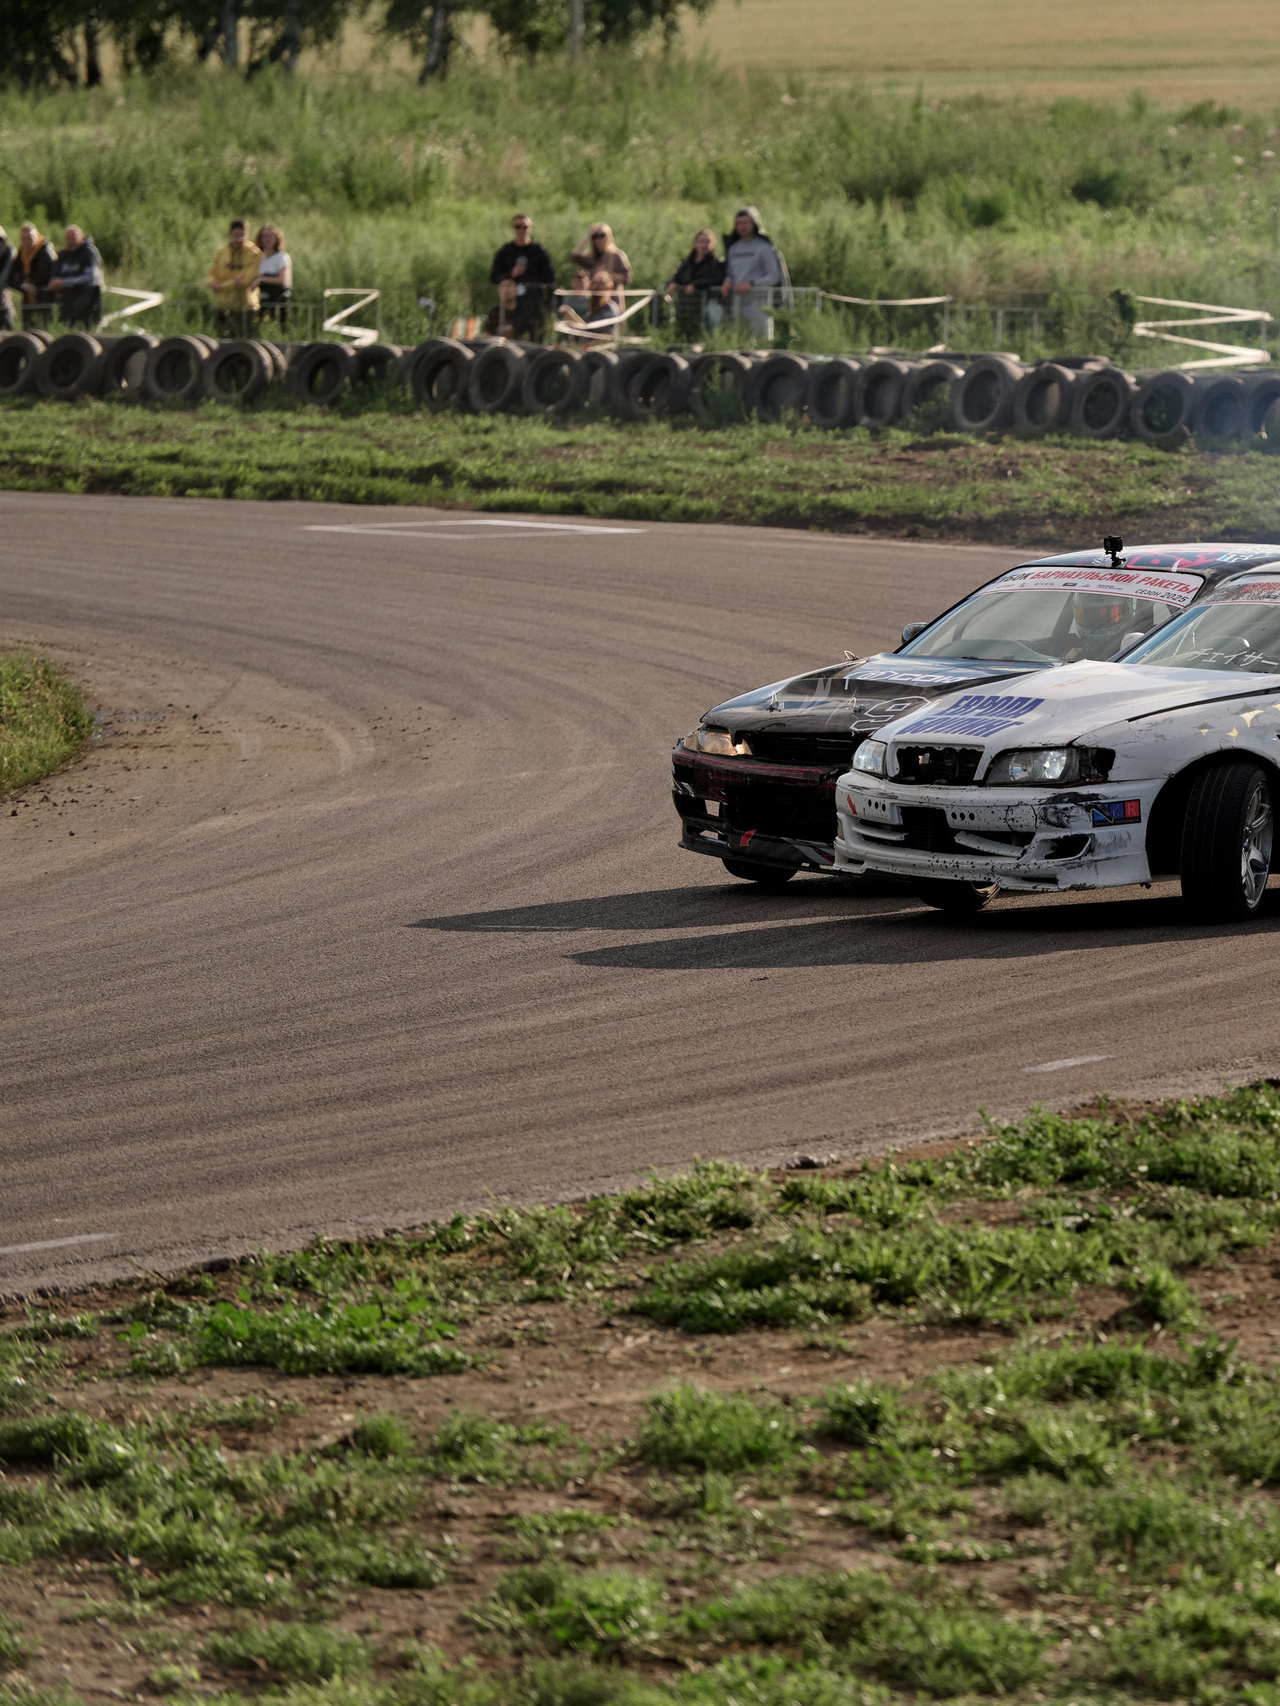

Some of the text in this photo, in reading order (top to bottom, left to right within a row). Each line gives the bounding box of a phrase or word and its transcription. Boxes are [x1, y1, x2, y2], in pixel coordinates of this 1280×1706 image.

[1030, 571, 1137, 584] БАРНАУЛЬСКОЙ
[1140, 576, 1199, 594] РАКЕТЫ
[1134, 588, 1188, 602] СЕЗОН 2025
[934, 695, 1046, 719] ЕВРОПА
[894, 716, 1026, 738] БОУЛИНГ
